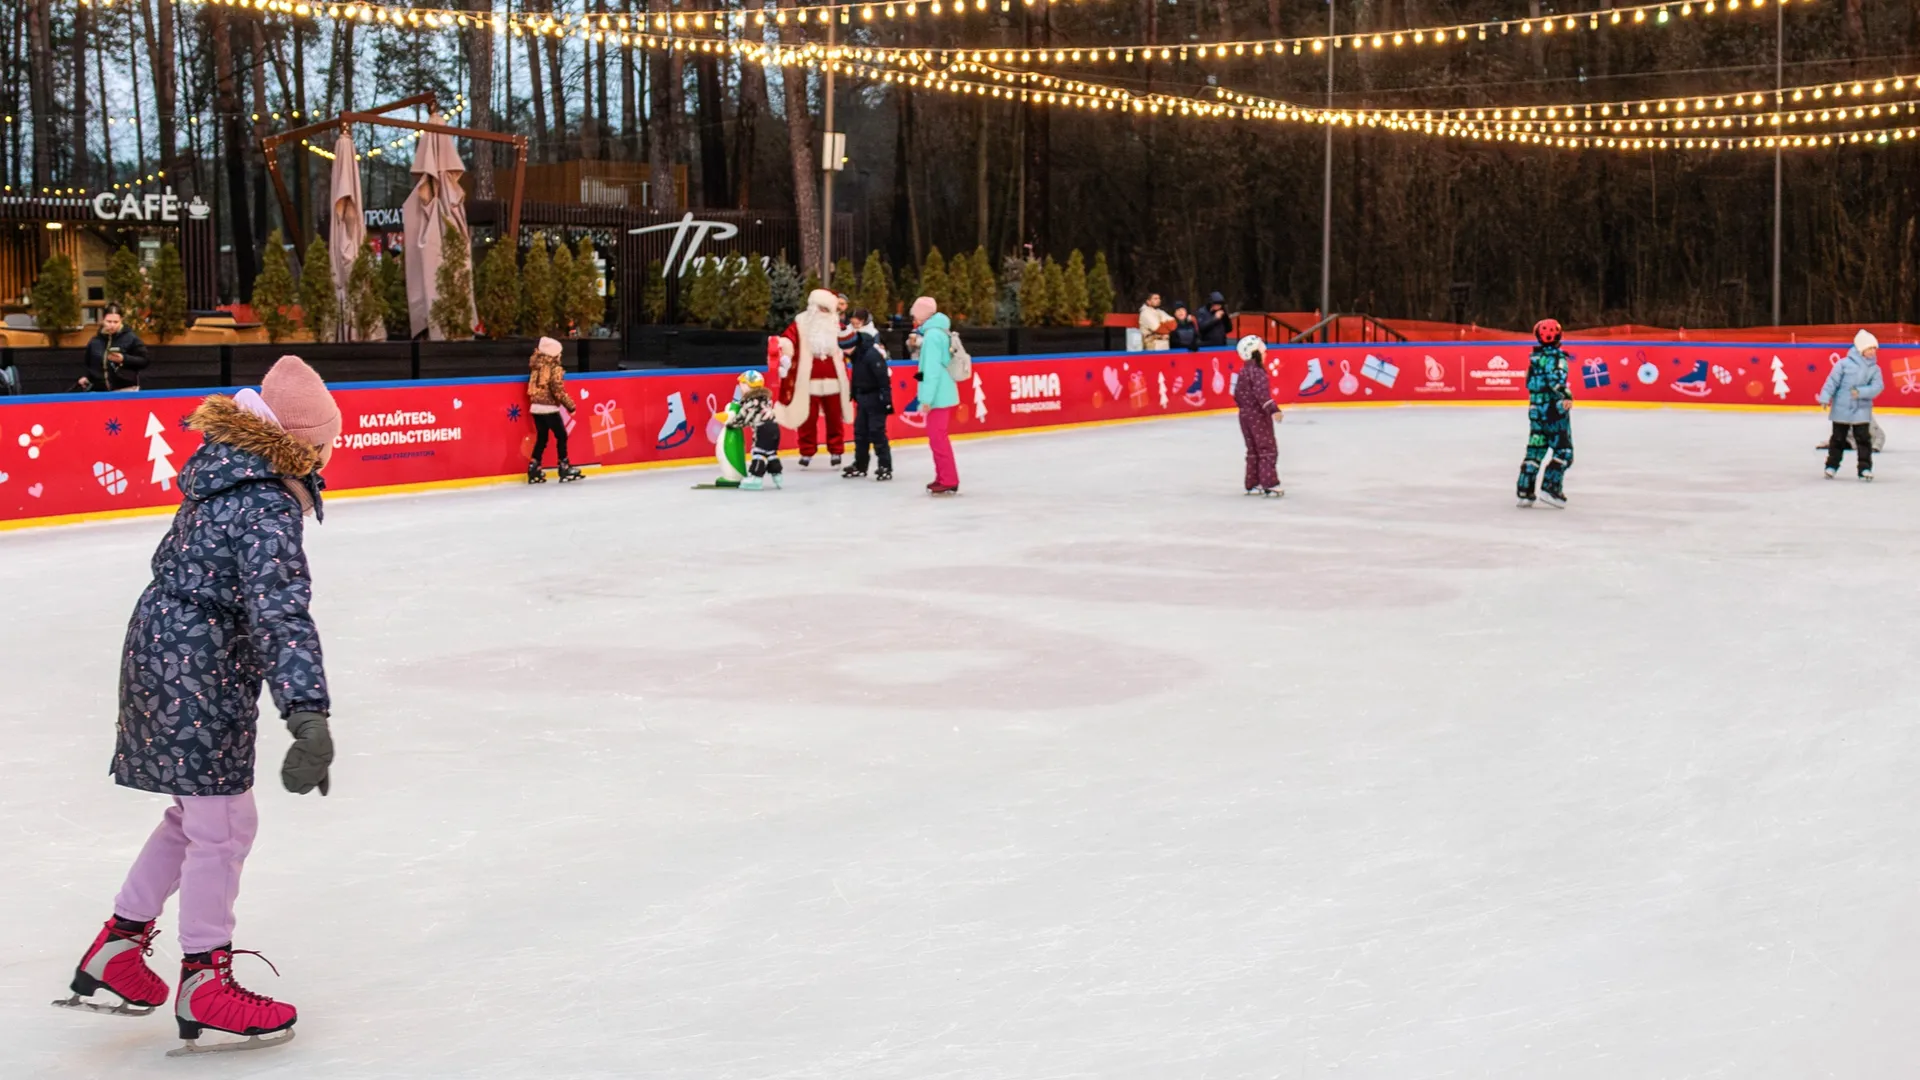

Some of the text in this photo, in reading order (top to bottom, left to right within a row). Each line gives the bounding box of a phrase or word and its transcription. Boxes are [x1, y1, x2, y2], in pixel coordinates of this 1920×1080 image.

[1009, 372, 1061, 400] ЗИМА
[359, 410, 436, 428] КАТАЙТЕСЬ
[332, 427, 462, 449] С УДОВОЛЬСТВИЕМ!
